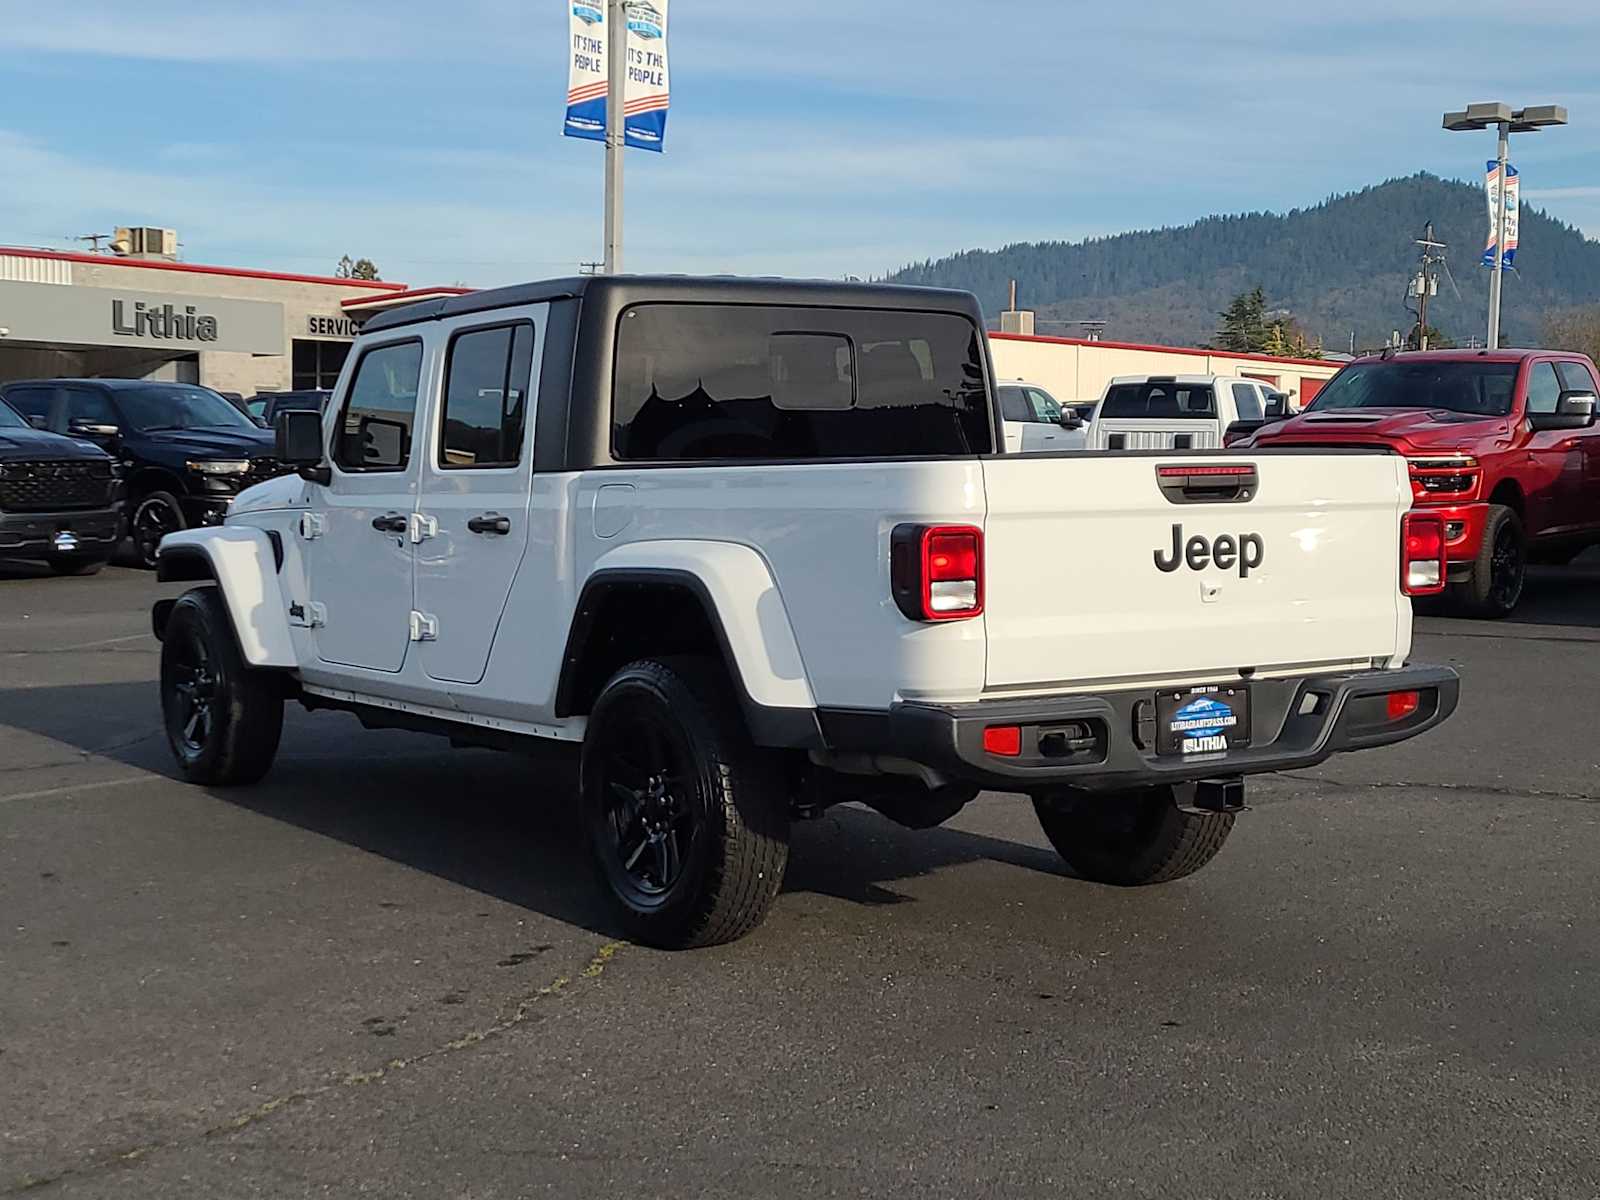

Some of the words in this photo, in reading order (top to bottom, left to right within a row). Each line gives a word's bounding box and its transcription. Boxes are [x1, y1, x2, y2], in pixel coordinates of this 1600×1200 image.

[573, 34, 588, 49] IT'S
[588, 38, 603, 54] THE
[574, 54, 601, 73] PEOPLE
[627, 48, 642, 64] IT'S
[646, 52, 664, 68] THE
[628, 67, 664, 86] PEOPLE
[112, 300, 218, 342] Lithia
[1153, 523, 1264, 579] Jeep
[1194, 735, 1227, 751] LITHIA
